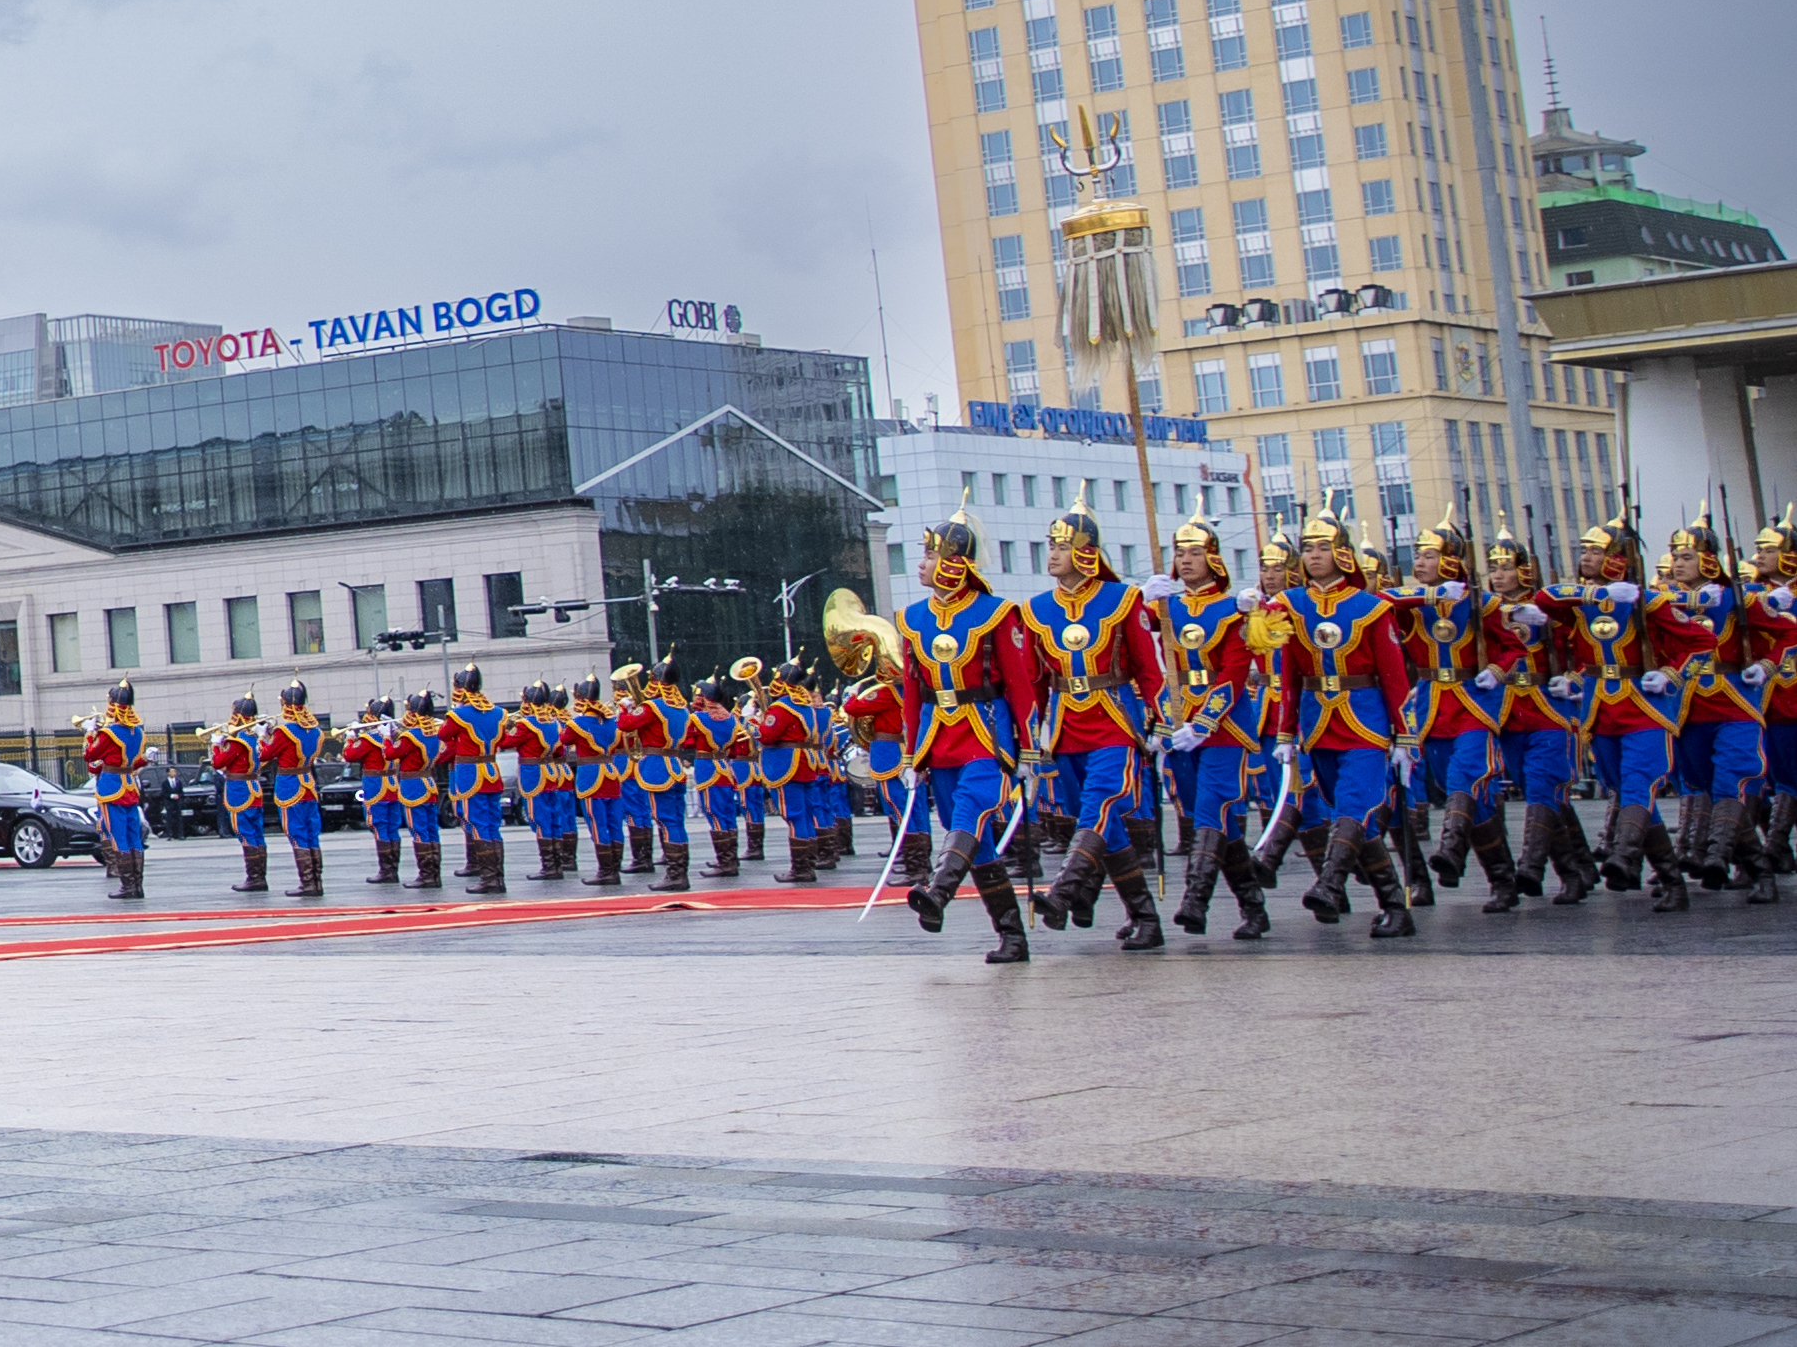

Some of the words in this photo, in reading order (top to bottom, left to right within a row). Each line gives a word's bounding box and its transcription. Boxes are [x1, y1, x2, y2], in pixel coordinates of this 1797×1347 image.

[153, 327, 282, 372] TOYOTA
[308, 305, 423, 350] TAVAN
[433, 288, 541, 332] BOGD
[668, 299, 719, 331] GOBI
[968, 401, 1015, 436] БИД
[1041, 407, 1128, 443] ОРОНДОО
